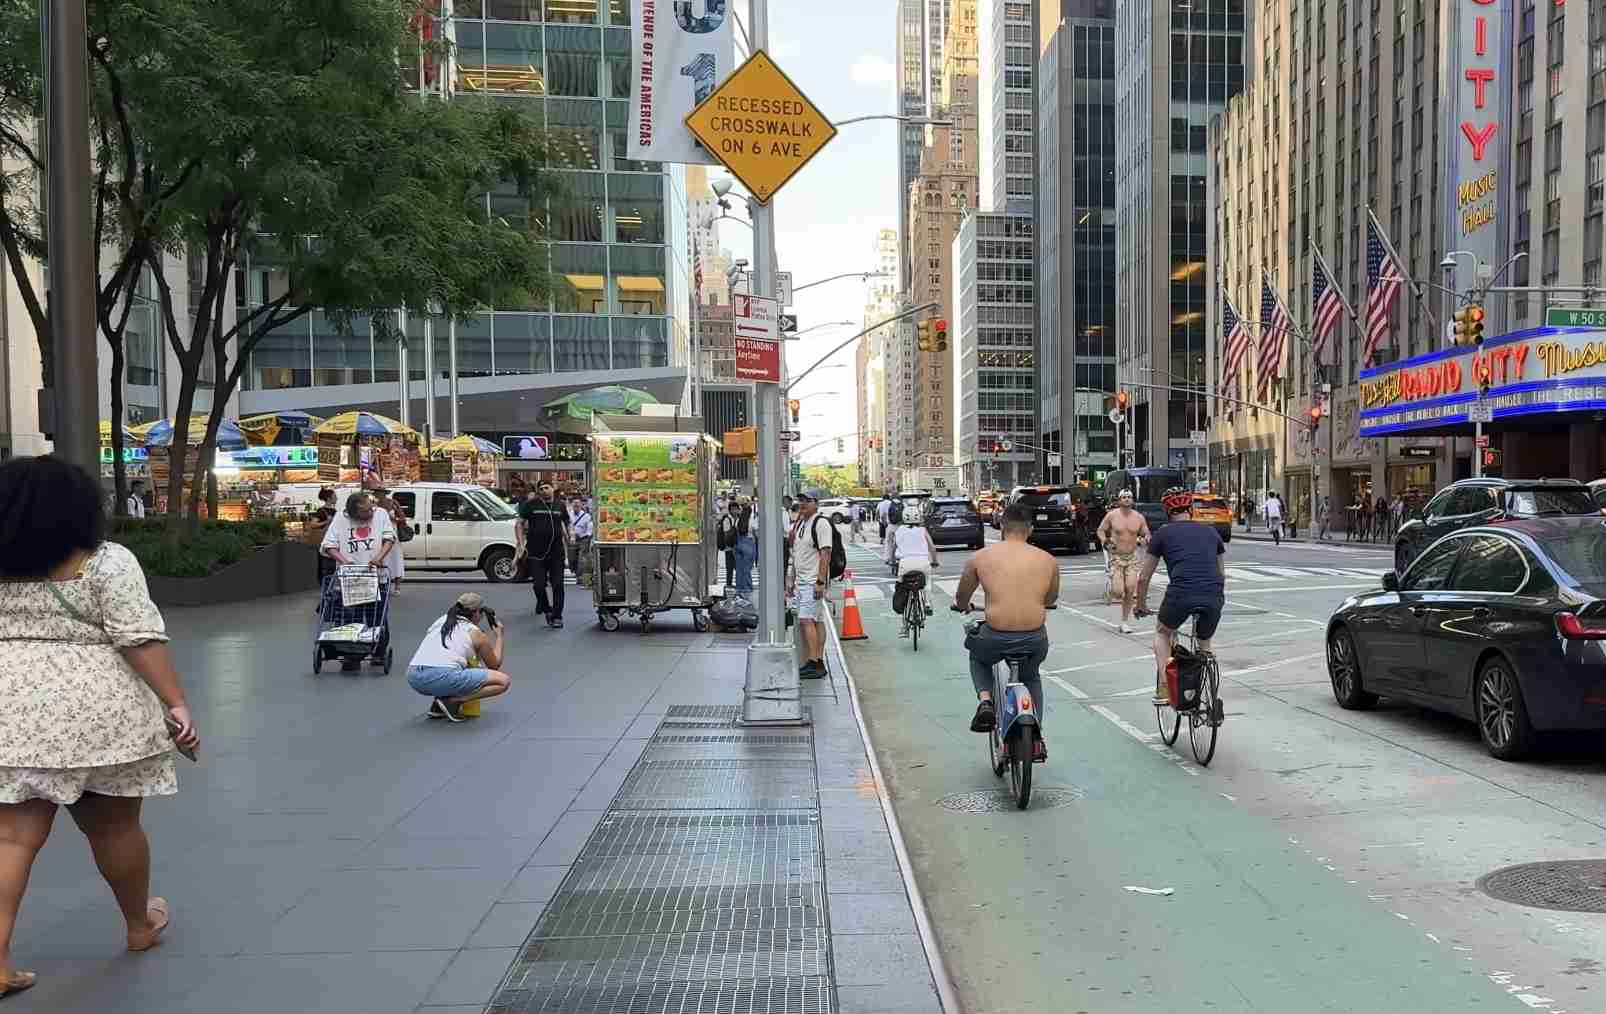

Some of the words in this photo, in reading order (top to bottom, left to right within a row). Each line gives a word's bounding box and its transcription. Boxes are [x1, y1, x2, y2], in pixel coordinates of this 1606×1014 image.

[642, 42, 654, 57] OF
[641, 61, 653, 81] THE
[1460, 0, 1498, 161] ITY
[717, 96, 804, 115] RECESSED
[639, 85, 652, 146] AMERICAS
[710, 117, 812, 137] CROSSWALK
[721, 138, 744, 154] ON
[751, 142, 762, 155] 6
[770, 142, 801, 158] AVE
[1569, 311, 1578, 326] W
[1581, 312, 1594, 325] 50
[1598, 313, 1606, 326] S
[746, 341, 775, 353] STANDING
[1400, 361, 1462, 400] RADIO
[347, 527, 356, 540] I
[347, 538, 375, 553] NY
